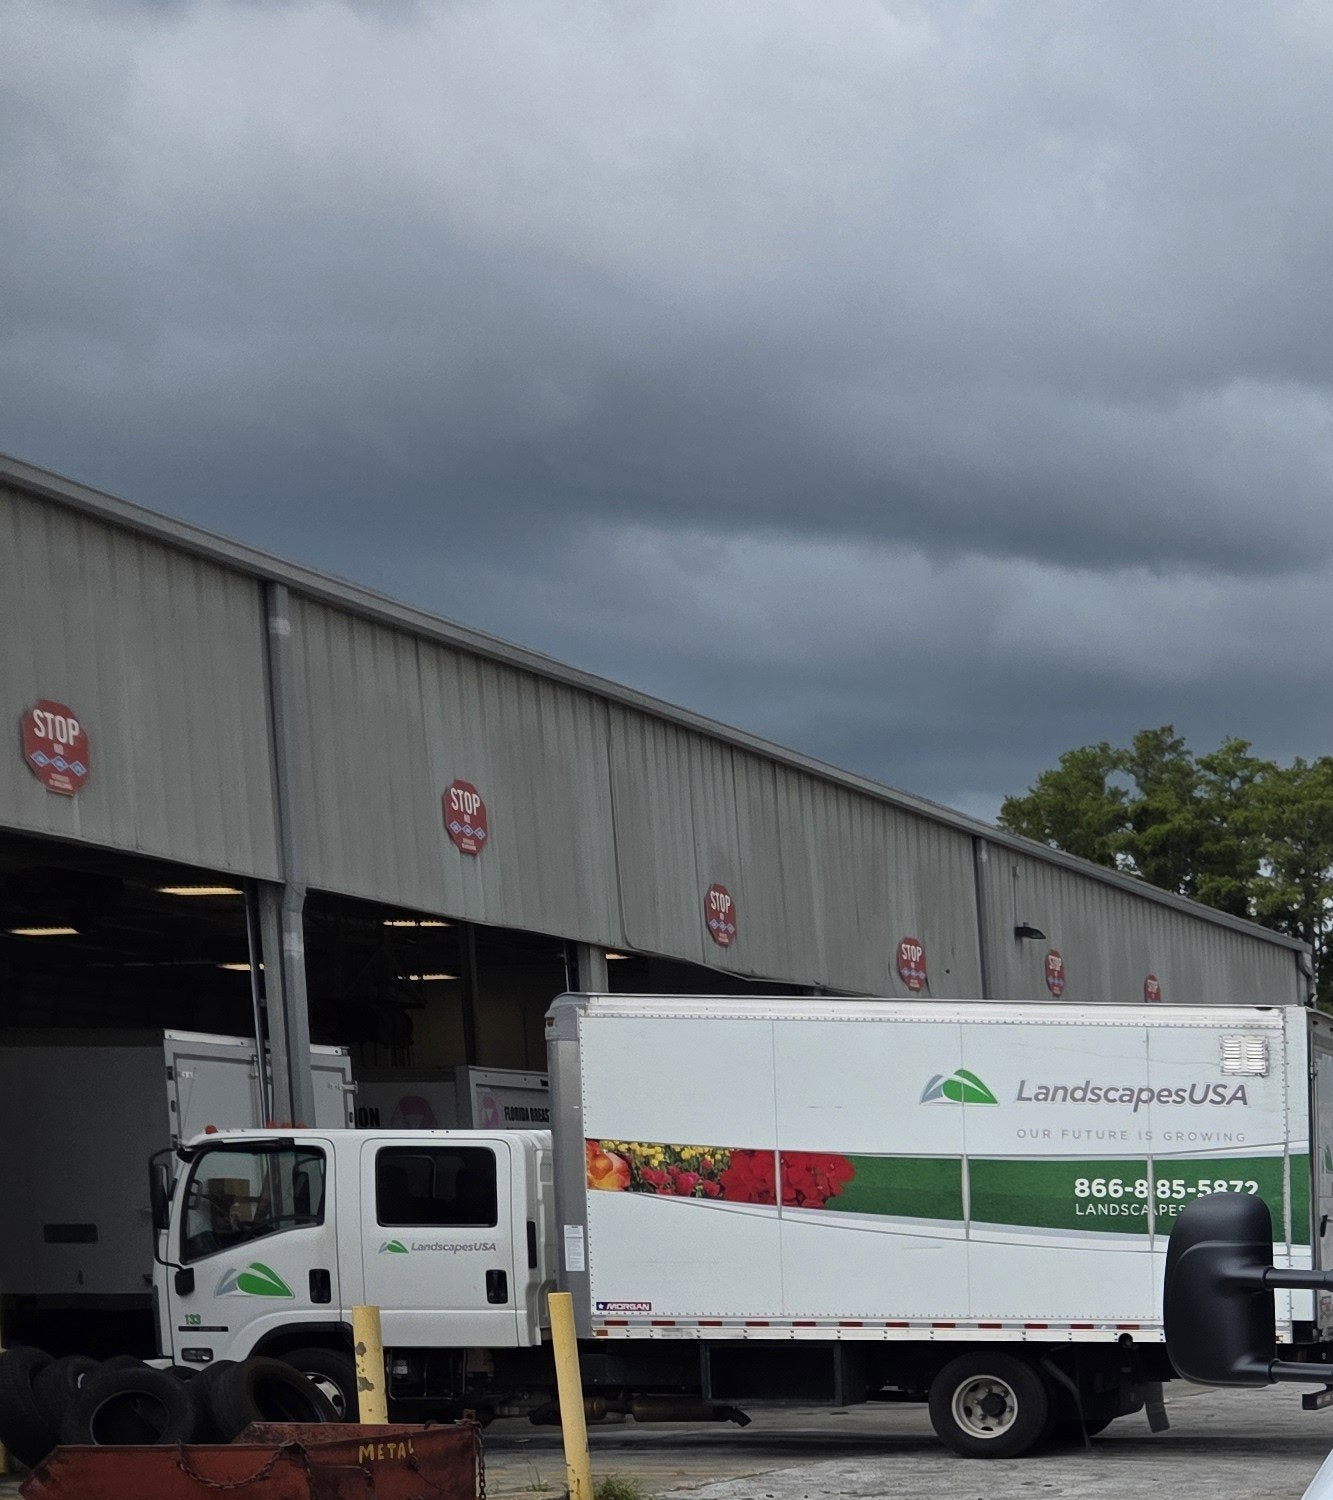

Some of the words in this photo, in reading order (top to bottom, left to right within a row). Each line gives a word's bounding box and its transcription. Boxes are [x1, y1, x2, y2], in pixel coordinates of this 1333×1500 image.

[33, 709, 79, 746] STOP
[450, 787, 480, 816] STOP
[710, 890, 730, 913] STOP
[901, 943, 922, 962] STOP
[1016, 1079, 1248, 1112] LandscapesUSA
[504, 1106, 529, 1122] FLORIDA
[1016, 1128, 1051, 1139] OUR
[1061, 1129, 1128, 1140] FUTURE
[1138, 1130, 1153, 1141] IS
[1163, 1130, 1246, 1142] GROWING
[411, 1242, 497, 1254] LandscapesUSA
[358, 1439, 415, 1464] METAL
